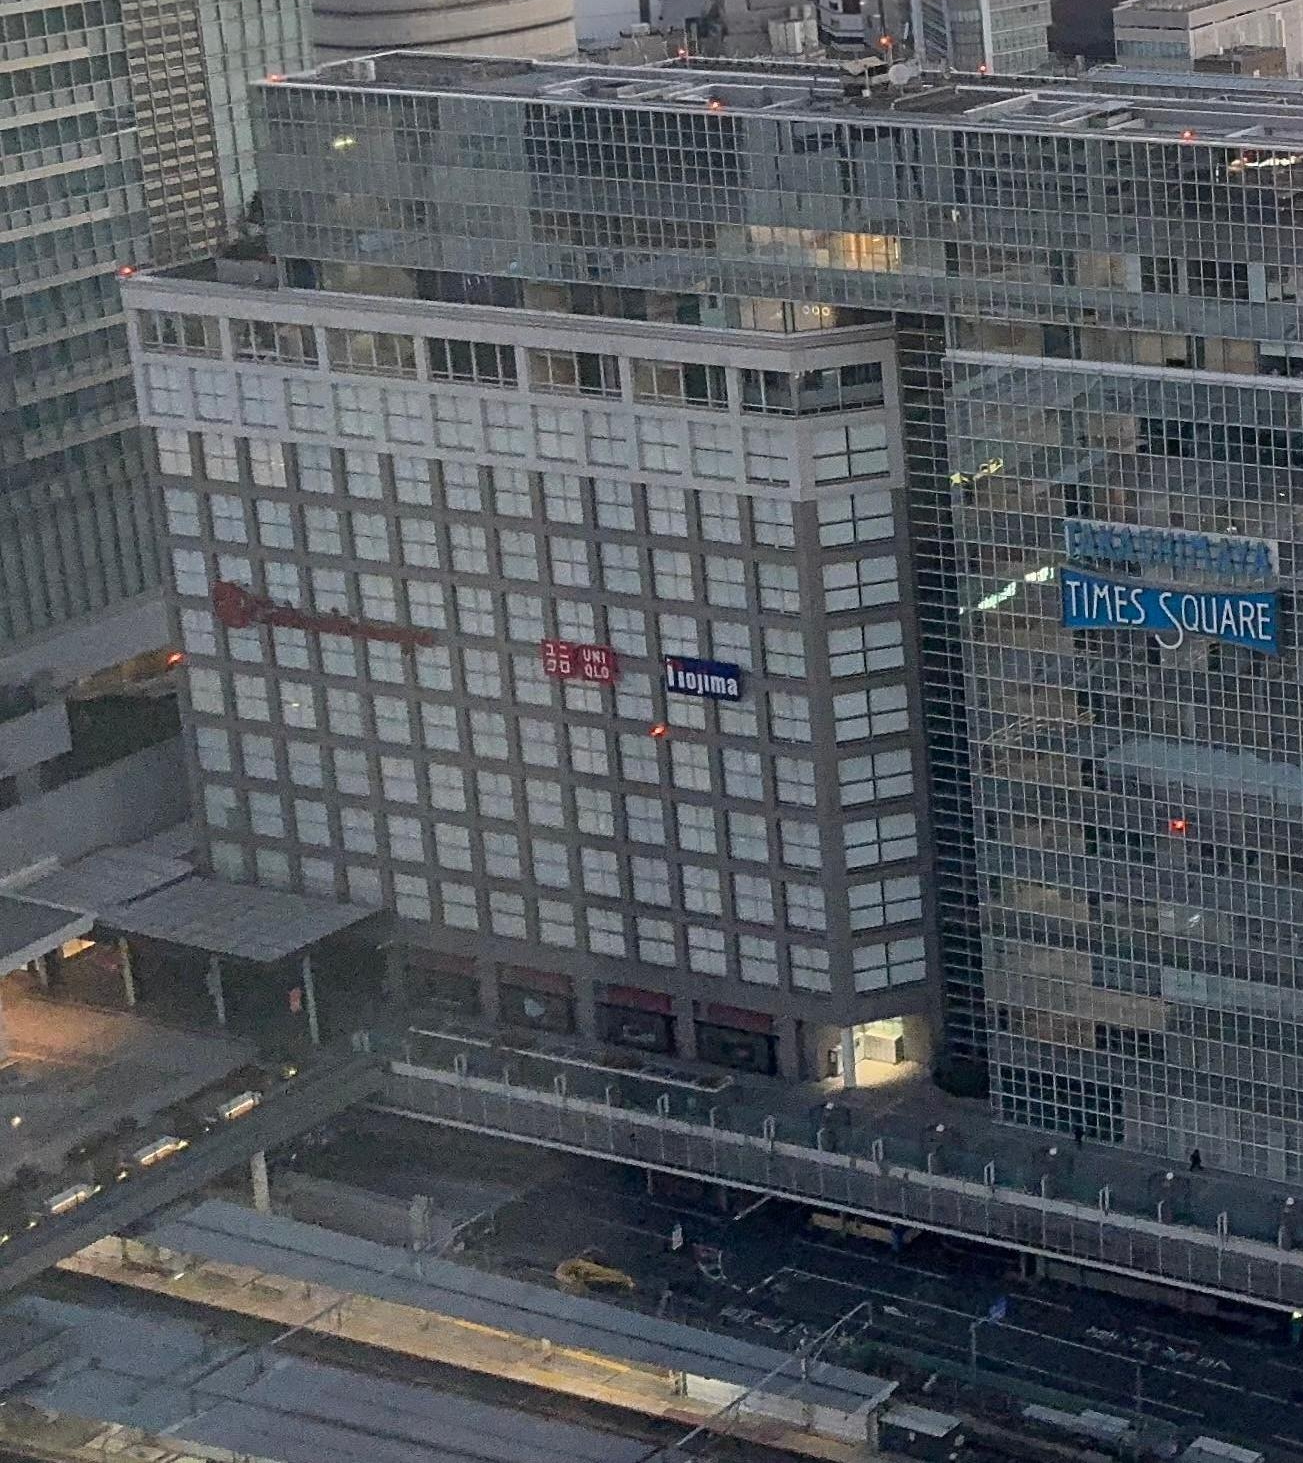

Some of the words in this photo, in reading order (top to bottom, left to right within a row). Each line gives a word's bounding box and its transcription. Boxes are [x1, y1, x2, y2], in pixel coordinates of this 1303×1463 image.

[1066, 580, 1146, 625] TIMES
[1155, 591, 1272, 650] SQUARE
[582, 648, 606, 664] UNI
[584, 663, 610, 679] QLO
